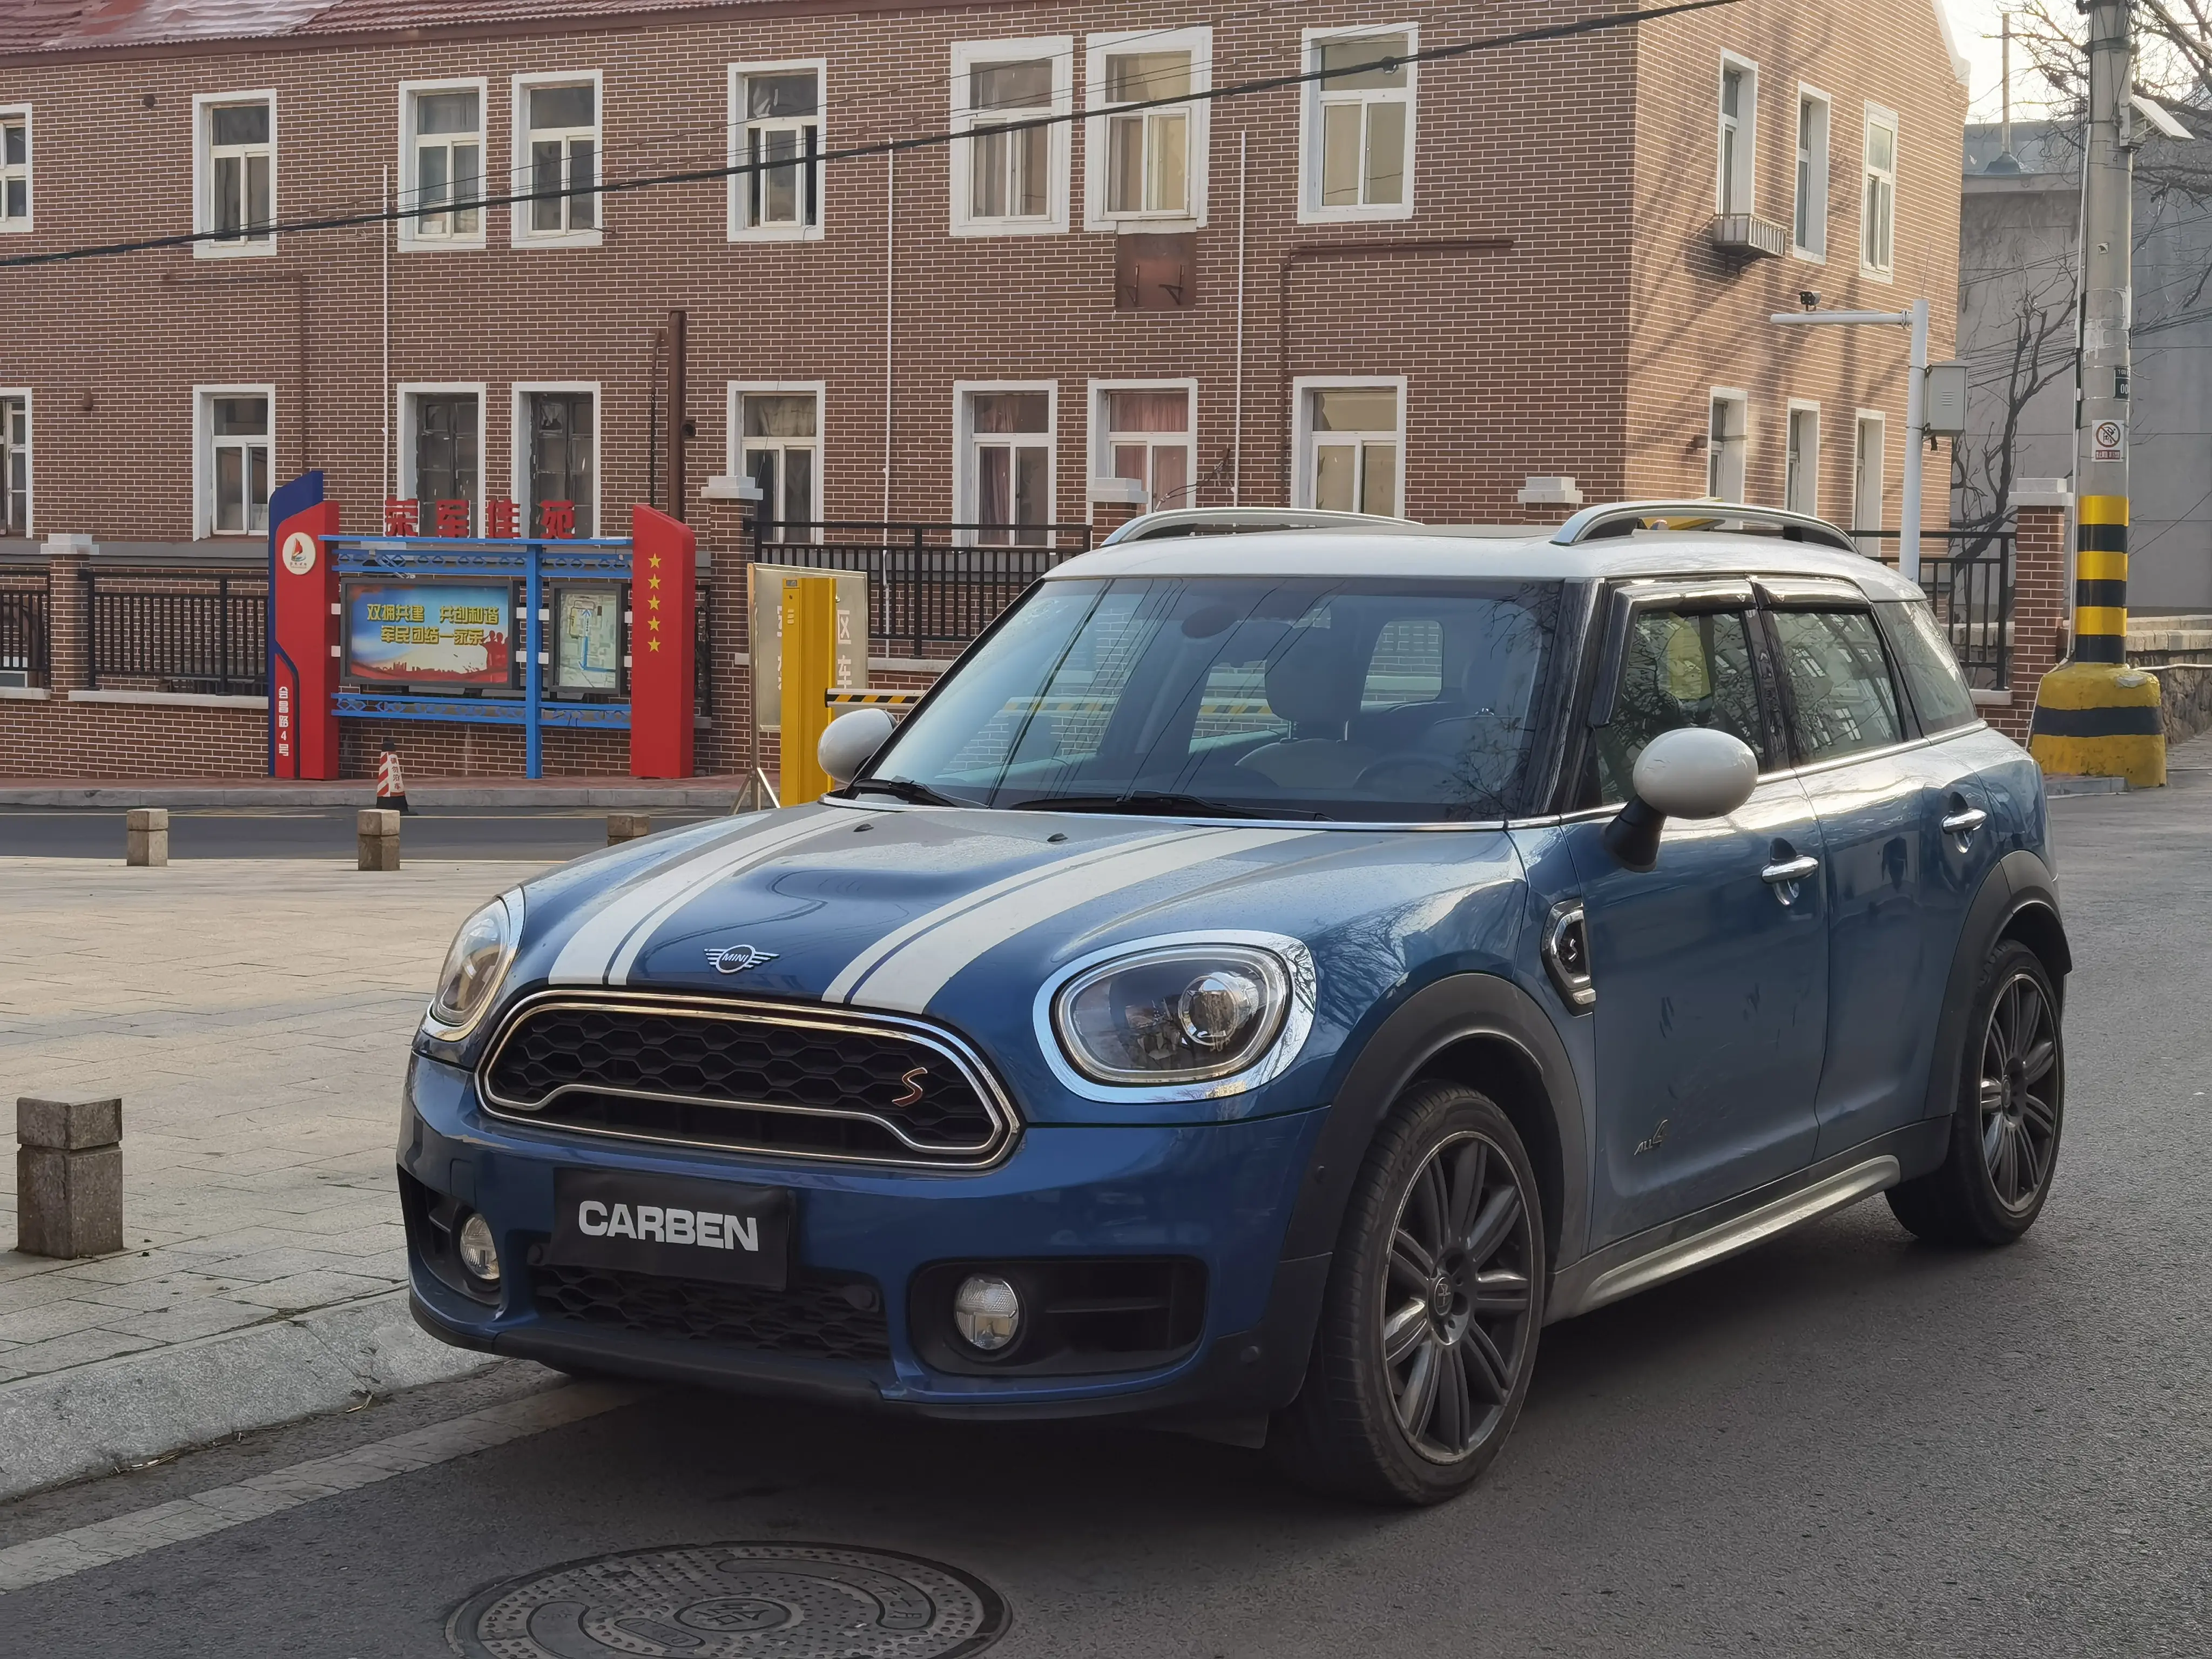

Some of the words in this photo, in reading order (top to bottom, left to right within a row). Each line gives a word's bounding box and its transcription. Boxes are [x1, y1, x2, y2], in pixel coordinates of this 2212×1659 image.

[385, 496, 575, 539] 荣军佳苑
[367, 603, 425, 623] 双拥共建
[439, 605, 500, 625] 共创和谐
[381, 625, 484, 645] 军民团结一家亲
[721, 953, 750, 962] MINI
[578, 1200, 759, 1252] CARBEN
